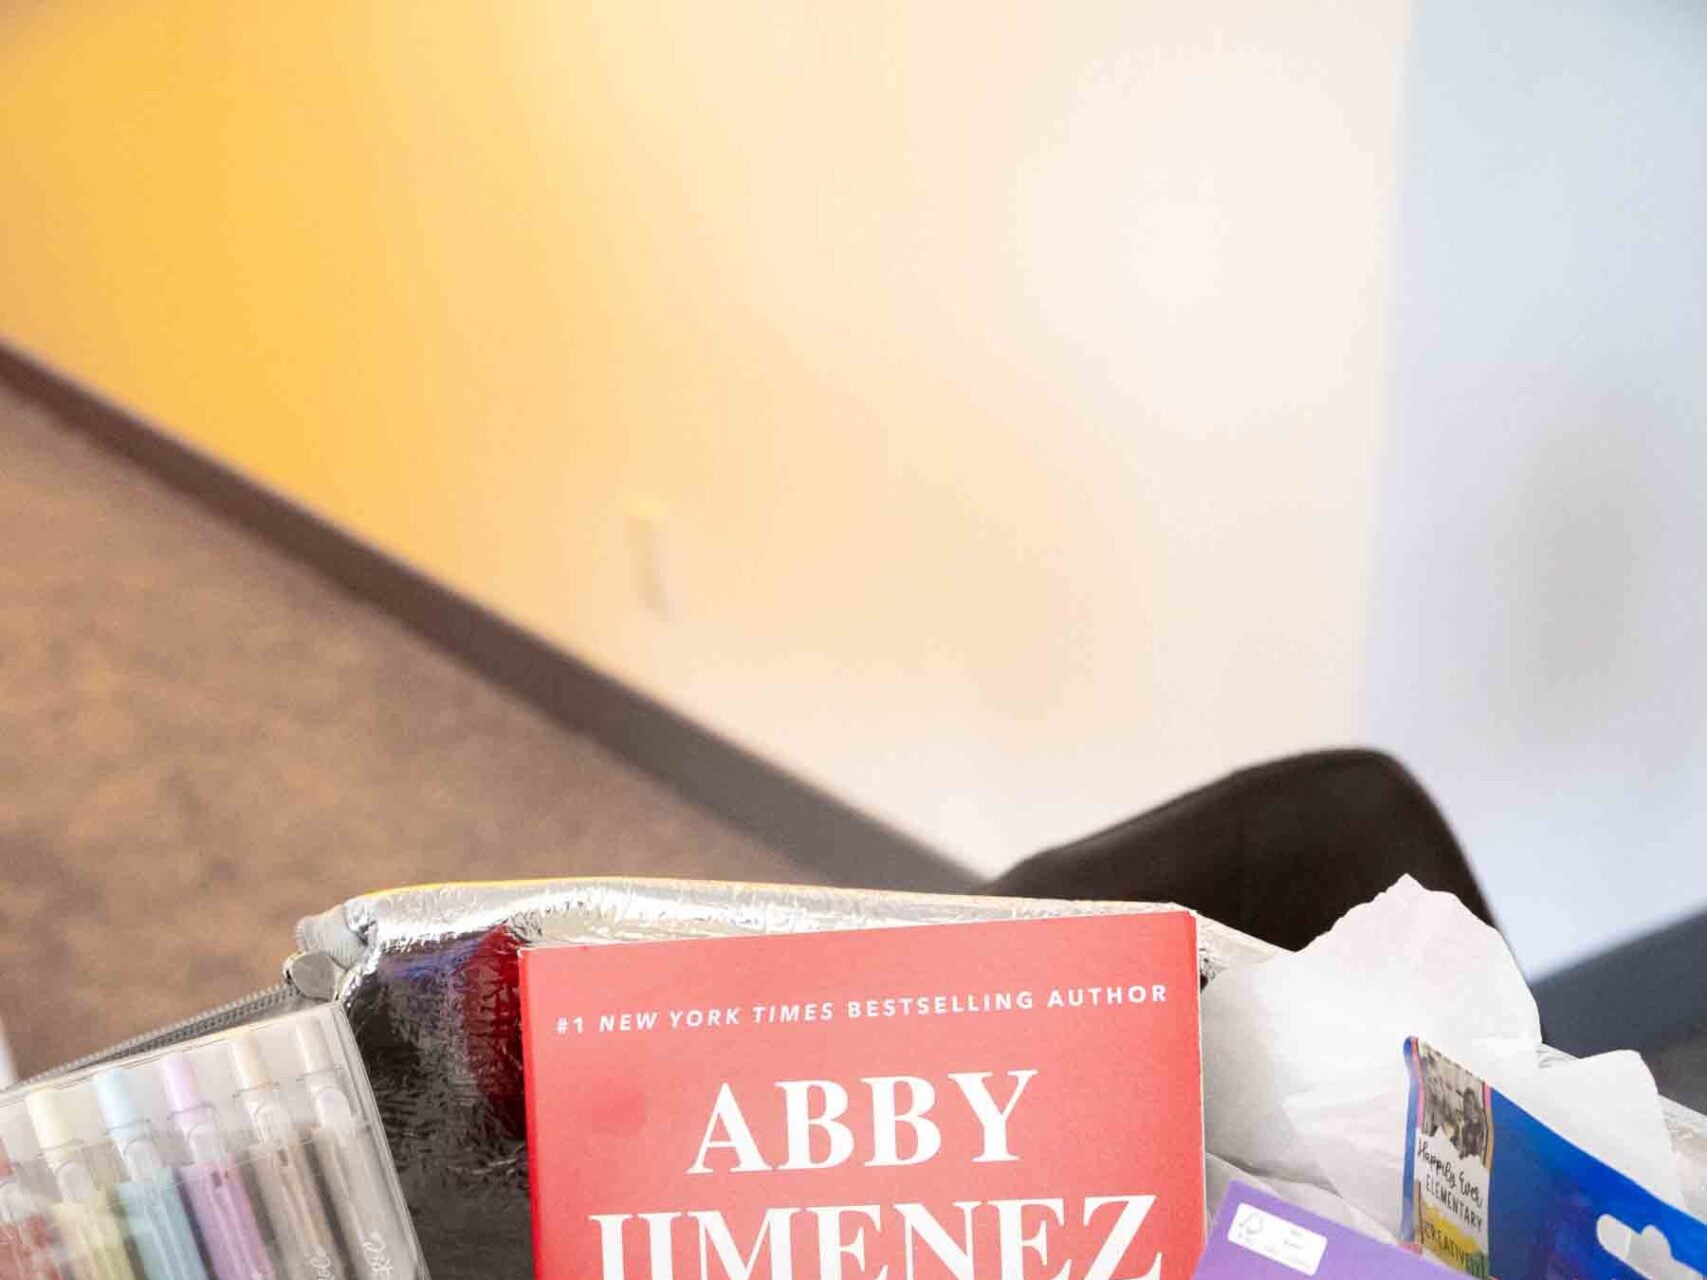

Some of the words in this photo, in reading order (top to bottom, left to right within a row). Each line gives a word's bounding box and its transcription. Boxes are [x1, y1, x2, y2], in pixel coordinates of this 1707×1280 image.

[557, 1016, 583, 1034] #1
[599, 1011, 658, 1032] NEW
[669, 1007, 741, 1028] YORK
[753, 1001, 834, 1024] TIMES
[848, 990, 1033, 1018] BESTSELLING
[1046, 984, 1167, 1008] AUTHOR
[686, 1069, 1039, 1174] ABBY
[1426, 1174, 1483, 1231] ELEMENTARY
